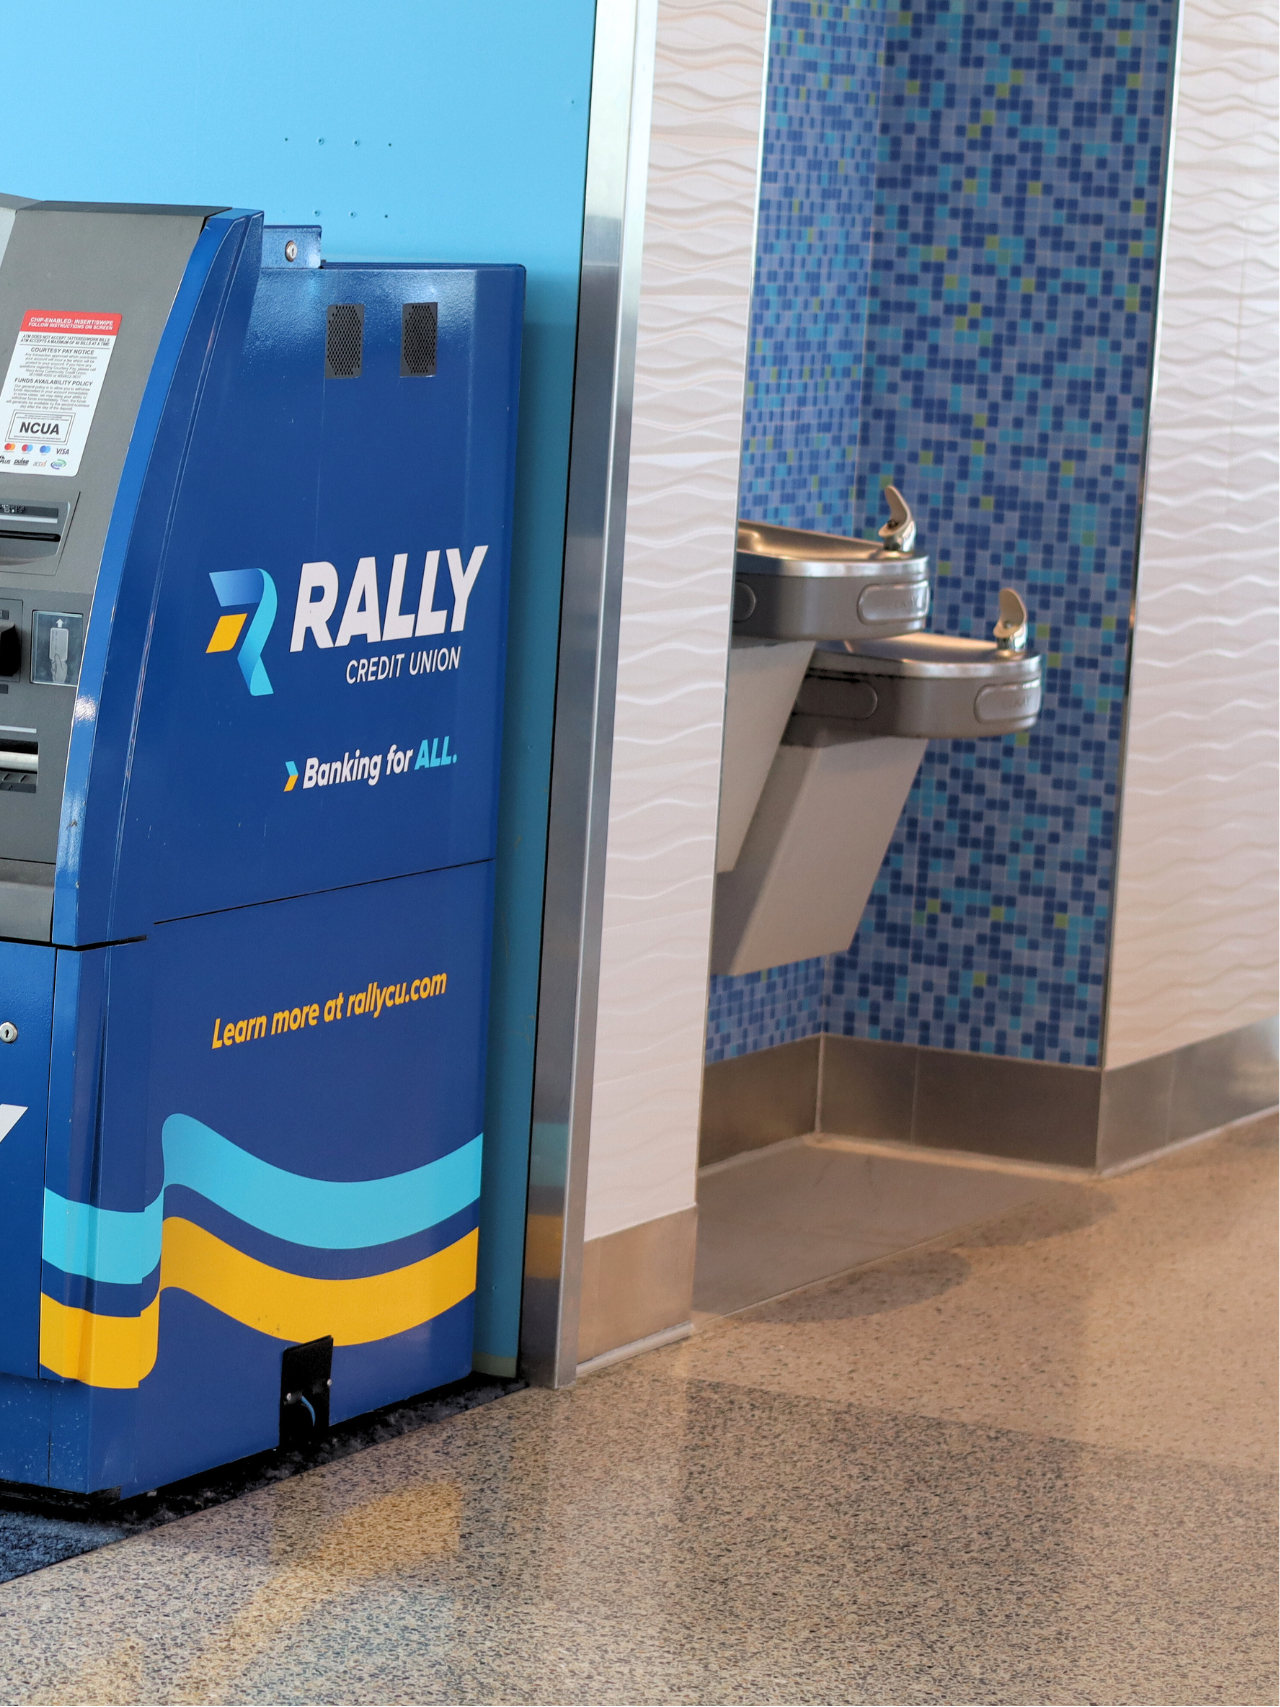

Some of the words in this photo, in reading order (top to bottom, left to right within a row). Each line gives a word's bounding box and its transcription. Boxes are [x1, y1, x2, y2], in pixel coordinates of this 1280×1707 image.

[19, 422, 59, 435] NCUA
[289, 545, 489, 653] RALLY
[345, 653, 405, 684] CREDIT
[409, 646, 462, 676] UNION
[302, 748, 383, 789] Banking
[386, 743, 414, 776] for
[414, 735, 458, 771] ALL.
[211, 1018, 268, 1049] Learn
[270, 1003, 320, 1035] more
[323, 992, 344, 1023] at
[346, 972, 448, 1018] rallycu.com
